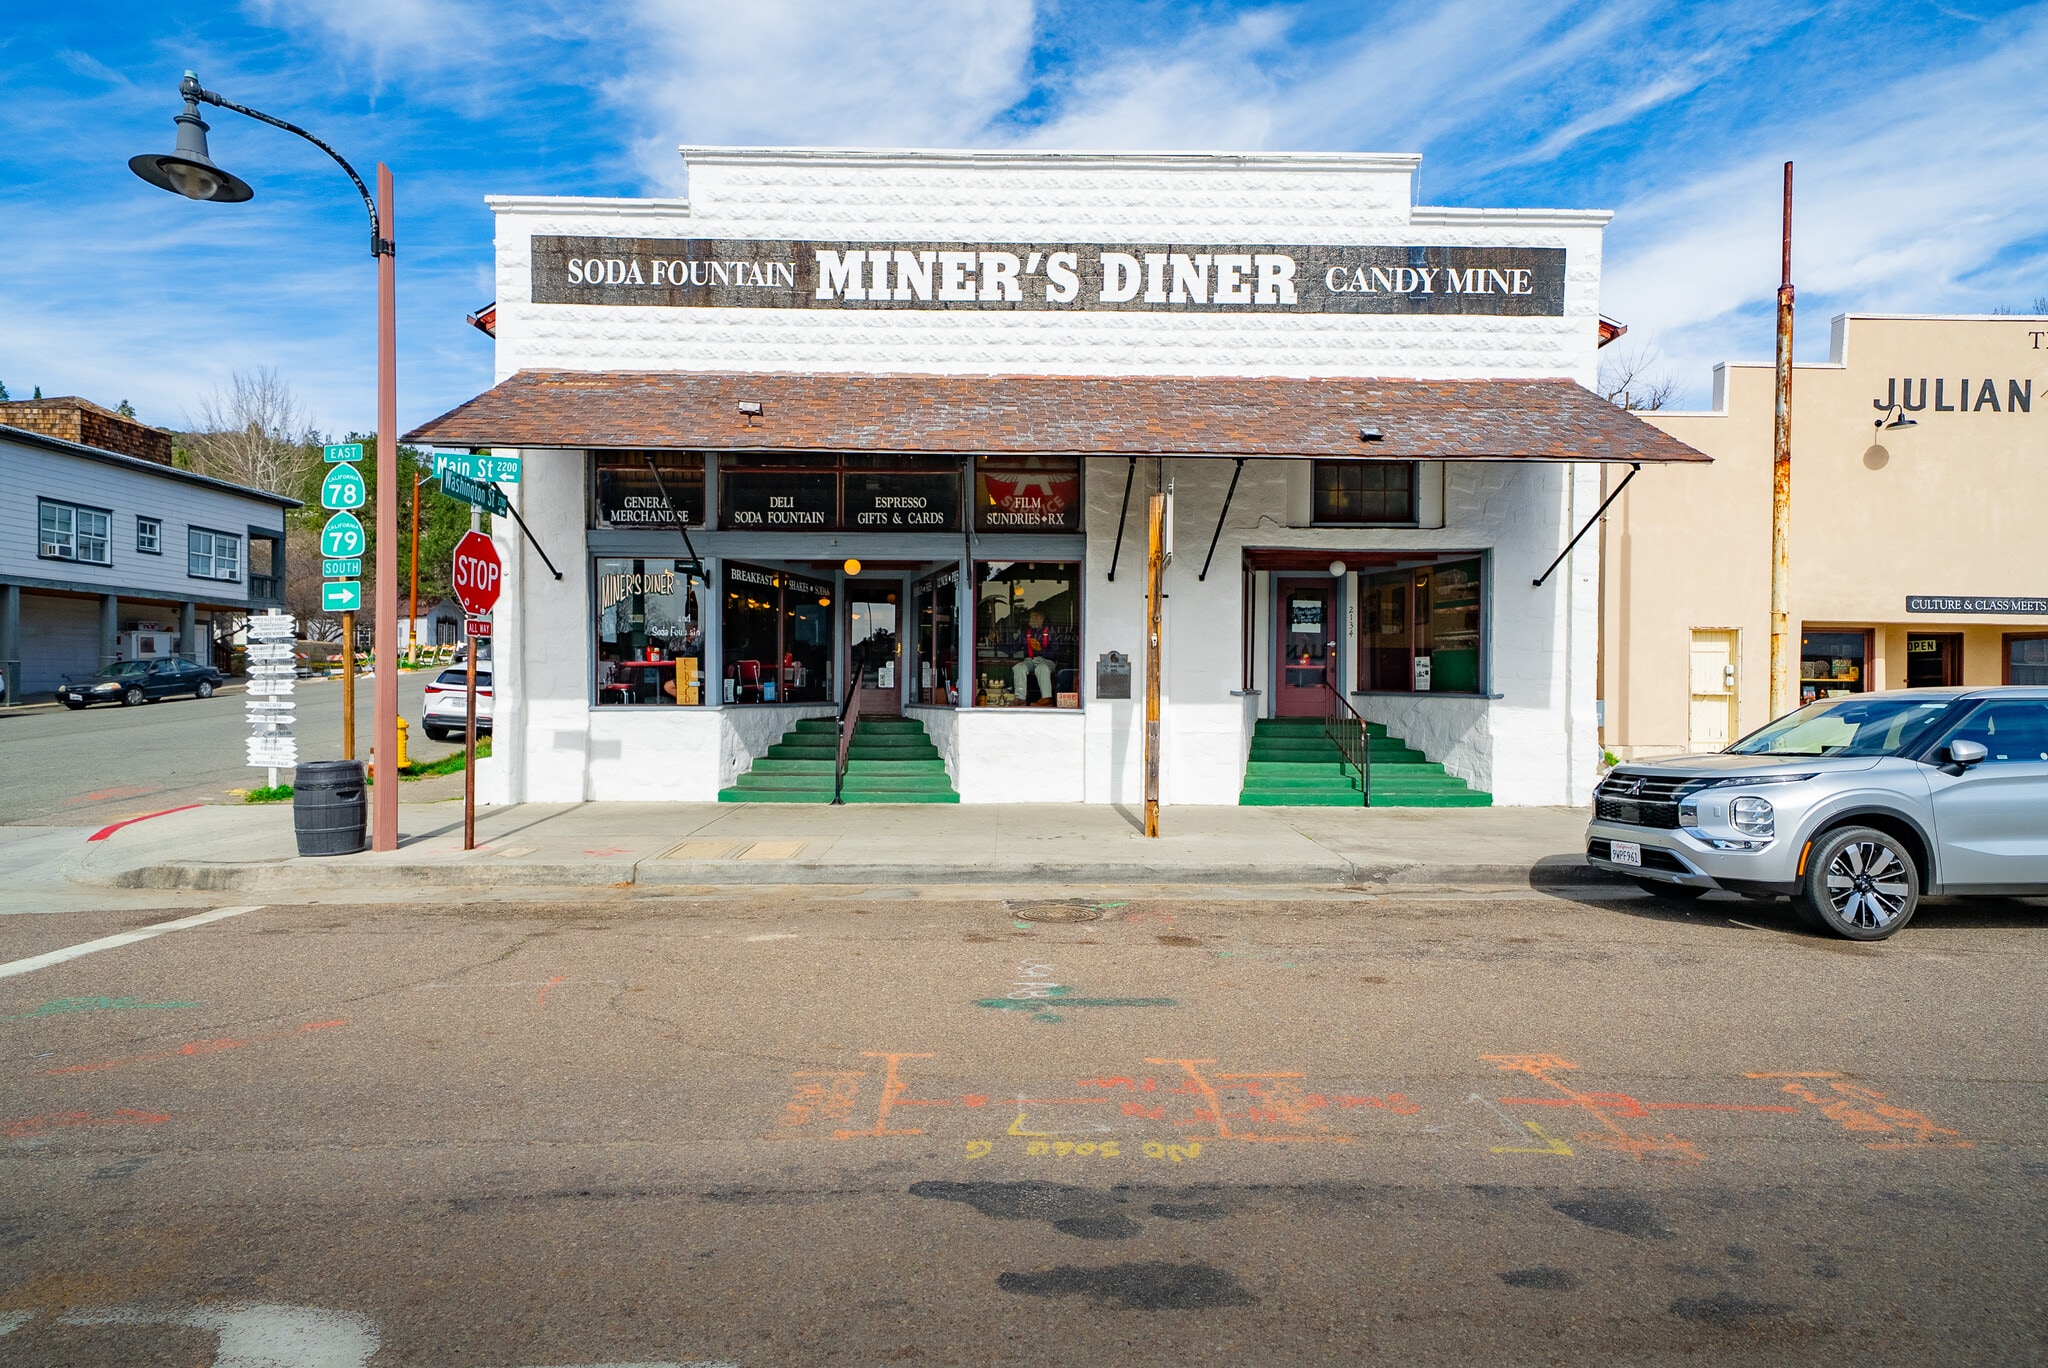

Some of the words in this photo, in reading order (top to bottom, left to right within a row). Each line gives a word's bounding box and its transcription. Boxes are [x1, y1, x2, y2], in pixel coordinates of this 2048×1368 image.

[567, 258, 645, 285] SODA
[650, 260, 796, 288] FOUNTAIN
[815, 249, 1080, 304] MINER'S
[1099, 252, 1298, 306] DINER
[1325, 266, 1441, 293] CANDY
[1446, 268, 1534, 295] MINE
[2028, 331, 2048, 350] T
[1873, 377, 2032, 413] JULIAN
[330, 447, 357, 459] EAST
[437, 456, 470, 477] Main
[477, 459, 493, 478] St
[497, 461, 518, 473] 2200
[327, 474, 359, 483] CALIFORNIA
[328, 483, 357, 505] 78
[444, 470, 486, 505] Washington
[487, 488, 496, 508] St
[623, 495, 676, 509] GENERA
[769, 496, 795, 508] DELI
[874, 496, 927, 509] ESPRESSO
[1014, 497, 1042, 509] FILM
[610, 510, 689, 522] MERCHANDSE
[734, 511, 763, 524] SODA
[767, 511, 825, 524] FOUNTAIN
[857, 512, 888, 525] GIFTS
[892, 512, 903, 525] &
[907, 511, 944, 525] CARDS
[986, 512, 1041, 525] SUNDRIES
[1048, 512, 1065, 525] RX
[326, 522, 359, 531] CALIFORNIA
[329, 531, 358, 553] 79
[325, 562, 359, 574] SOUTH
[456, 554, 499, 592] STOP
[730, 568, 774, 586] BREAKFAST
[788, 579, 809, 593] SHAKES
[601, 573, 642, 615] MINER'S
[644, 573, 674, 595] DINER
[1911, 599, 1962, 610] CULTURE
[1963, 600, 1974, 610] &
[1974, 600, 2009, 611] CLASS
[2011, 601, 2047, 611] MEETS
[468, 622, 479, 634] ALL
[479, 623, 490, 634] WAY
[1908, 641, 1934, 652] OPEN
